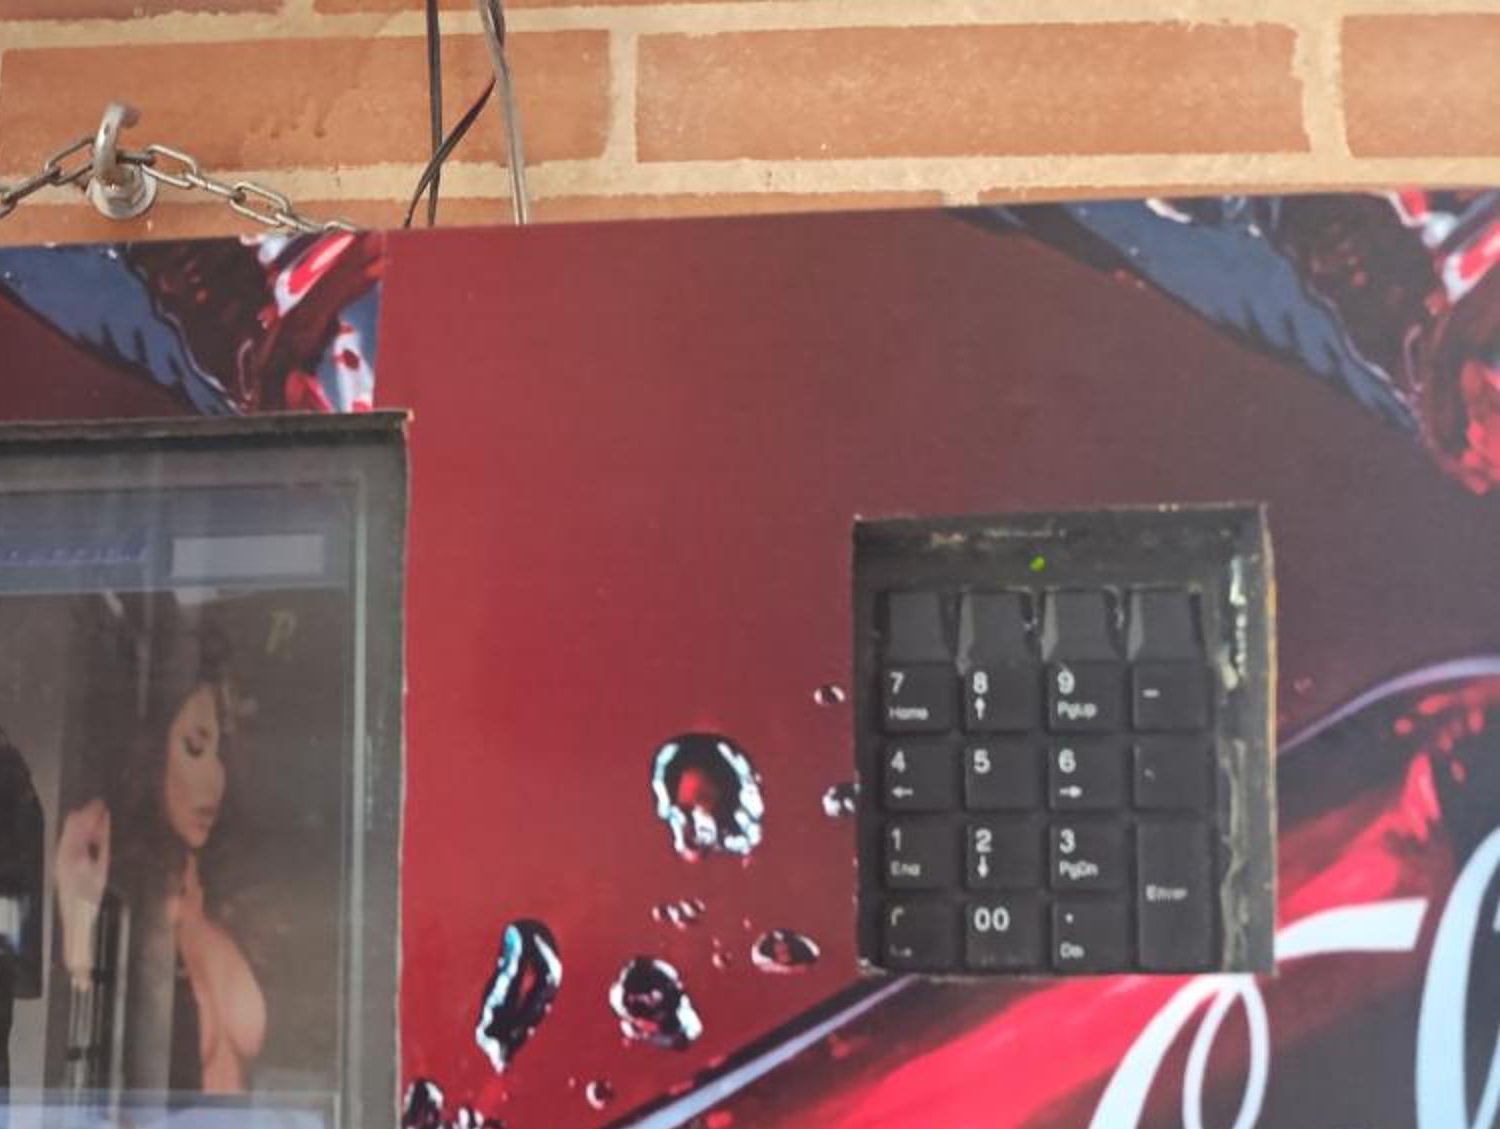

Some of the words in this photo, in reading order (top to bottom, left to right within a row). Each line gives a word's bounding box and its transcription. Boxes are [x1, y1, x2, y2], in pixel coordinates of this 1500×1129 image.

[889, 672, 905, 694] 7
[972, 672, 989, 694] 8
[1058, 672, 1076, 694] 9
[888, 705, 929, 721] Home
[890, 750, 906, 772] 4
[973, 750, 991, 773] 5
[1058, 750, 1076, 773] 6
[890, 829, 901, 851] 1
[976, 829, 993, 852] 2
[1059, 829, 1076, 852] 3
[974, 907, 1010, 931] 00
